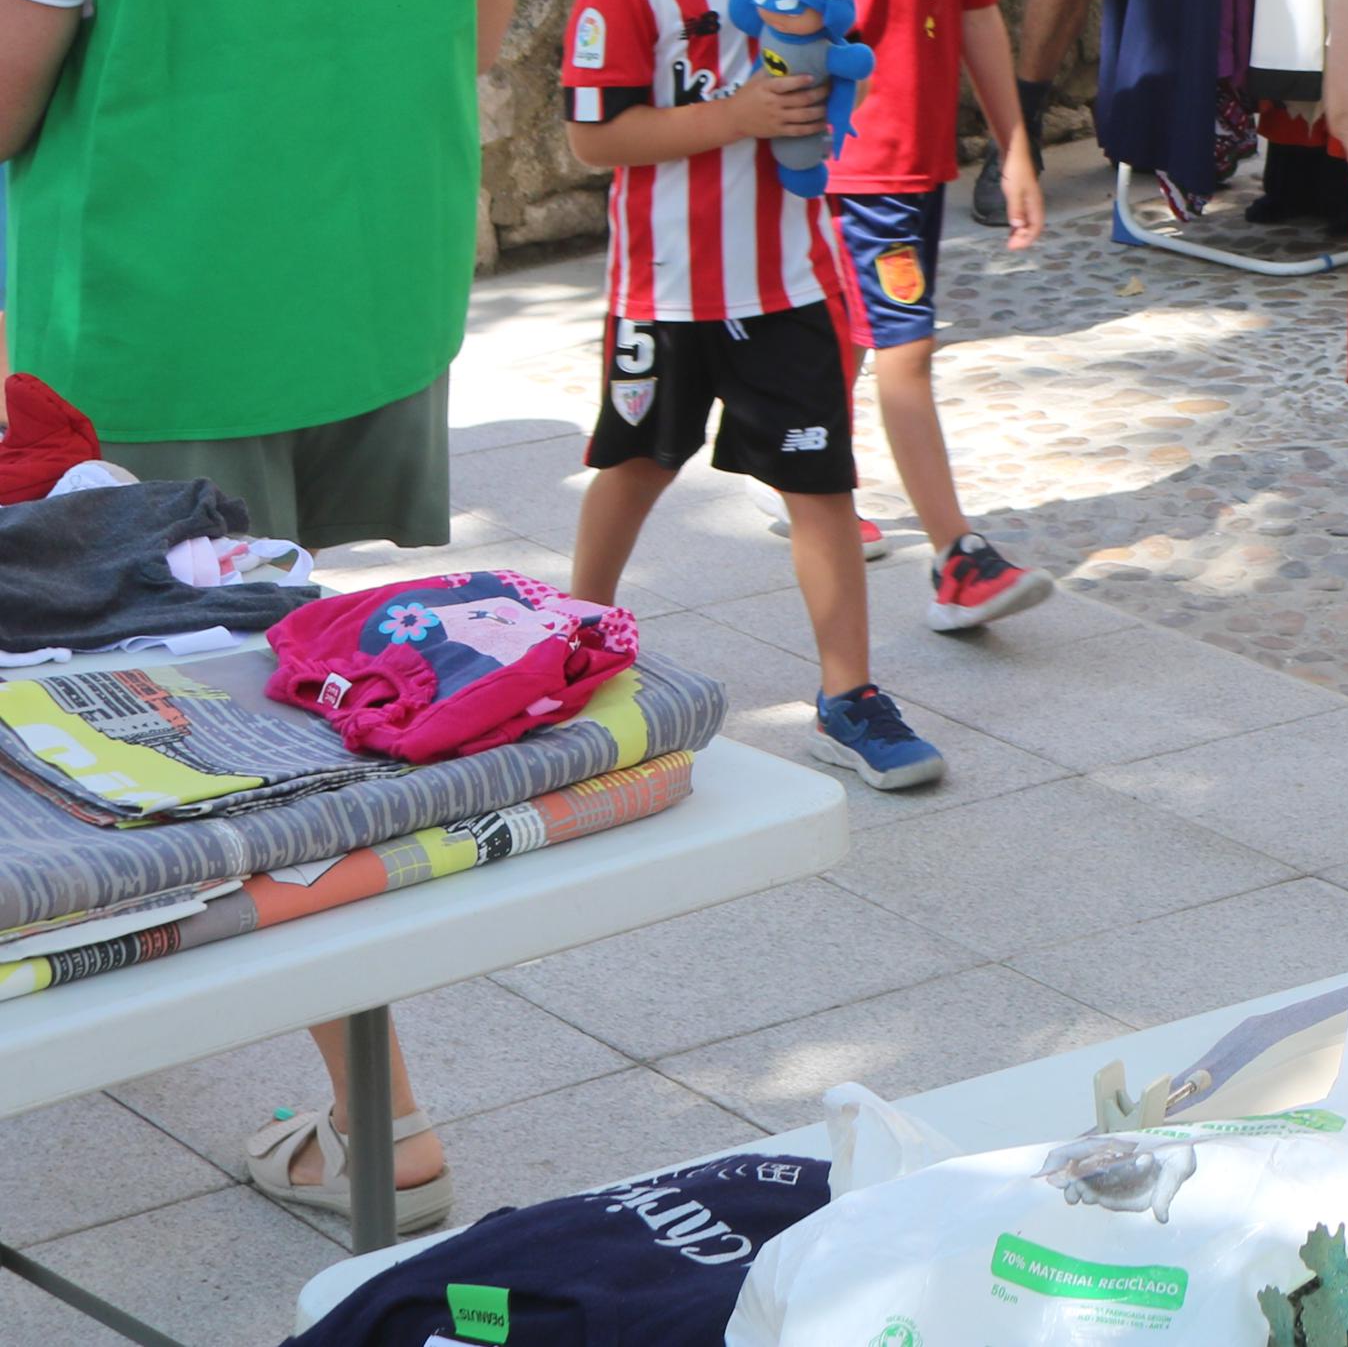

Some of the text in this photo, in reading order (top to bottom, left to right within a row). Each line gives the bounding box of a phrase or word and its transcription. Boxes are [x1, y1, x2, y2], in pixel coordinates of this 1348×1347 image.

[616, 320, 656, 374] 5
[1001, 1249, 1180, 1297] 70% MATERIAL RECICLADO
